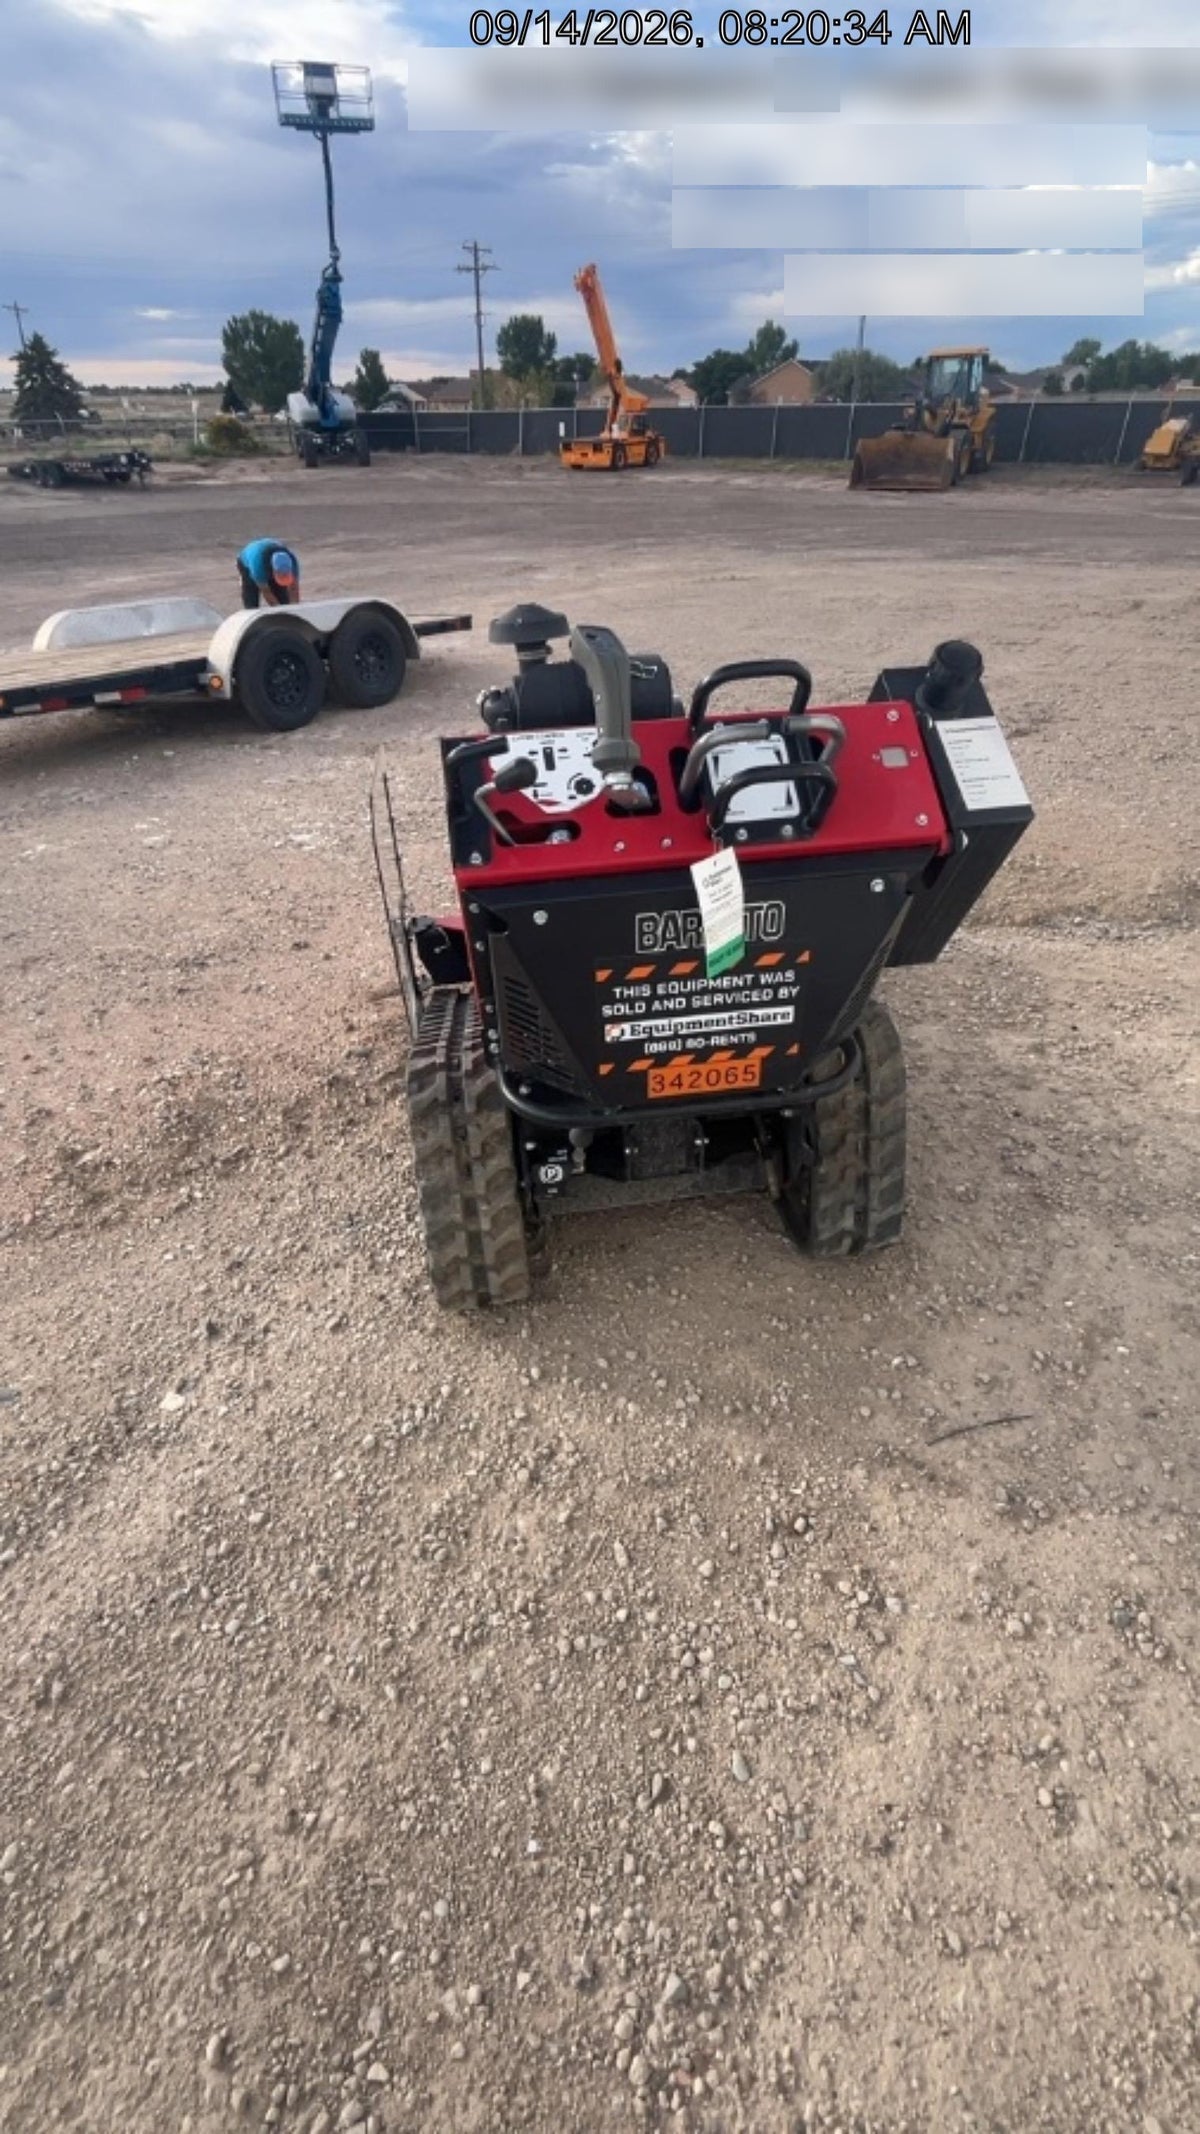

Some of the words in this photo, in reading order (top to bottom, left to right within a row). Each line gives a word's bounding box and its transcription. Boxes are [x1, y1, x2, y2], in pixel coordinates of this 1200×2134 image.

[635, 901, 786, 953] BARTO
[612, 984, 652, 999] THIS
[656, 973, 755, 995] EQUIPMENT
[760, 969, 796, 985] WAS
[601, 1001, 646, 1018] SOLD
[651, 997, 687, 1012] AND
[691, 987, 774, 1008] SERVICED
[777, 985, 800, 999] BY
[629, 1010, 791, 1039] EquipmentShare
[651, 1063, 757, 1094] 342065
